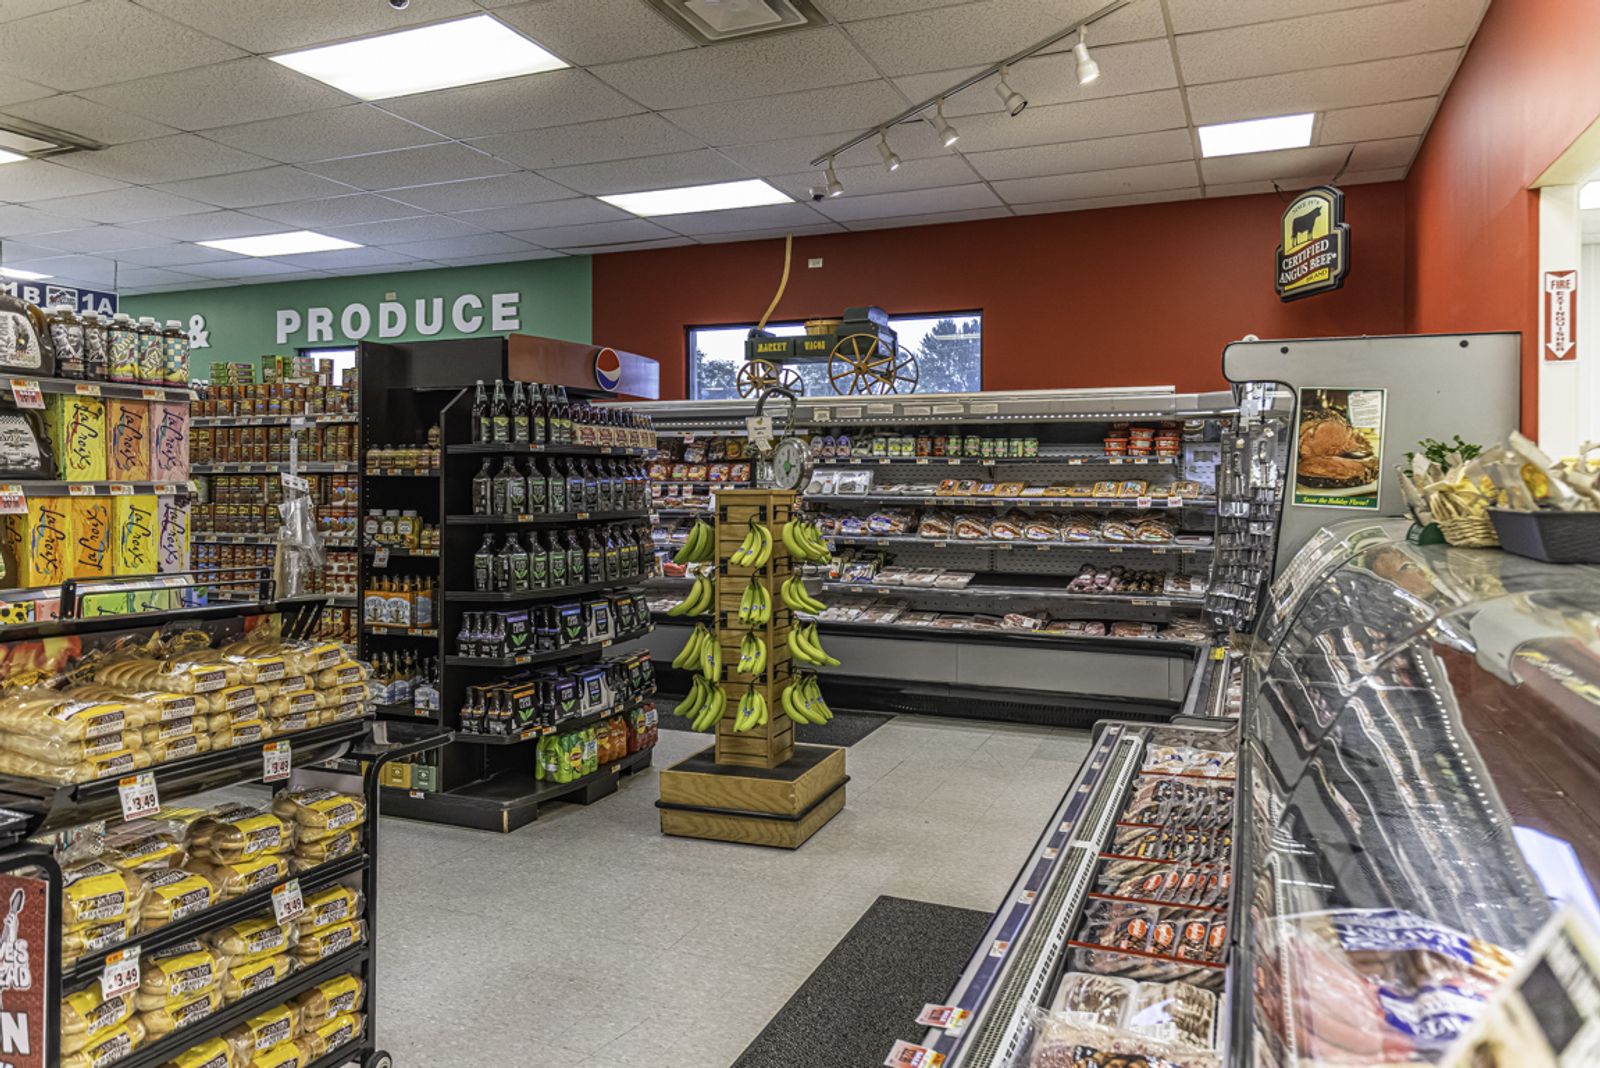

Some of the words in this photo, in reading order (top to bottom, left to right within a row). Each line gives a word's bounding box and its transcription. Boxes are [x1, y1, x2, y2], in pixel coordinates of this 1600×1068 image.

[1282, 239, 1329, 270] CERTIFIED
[1279, 261, 1308, 284] ANGUS
[4, 282, 41, 304] 1B
[1551, 280, 1570, 289] FIRE
[82, 293, 114, 316] 1A
[276, 292, 520, 344] PRODUCE
[757, 342, 787, 352] MARKET
[804, 340, 825, 351] WAGON
